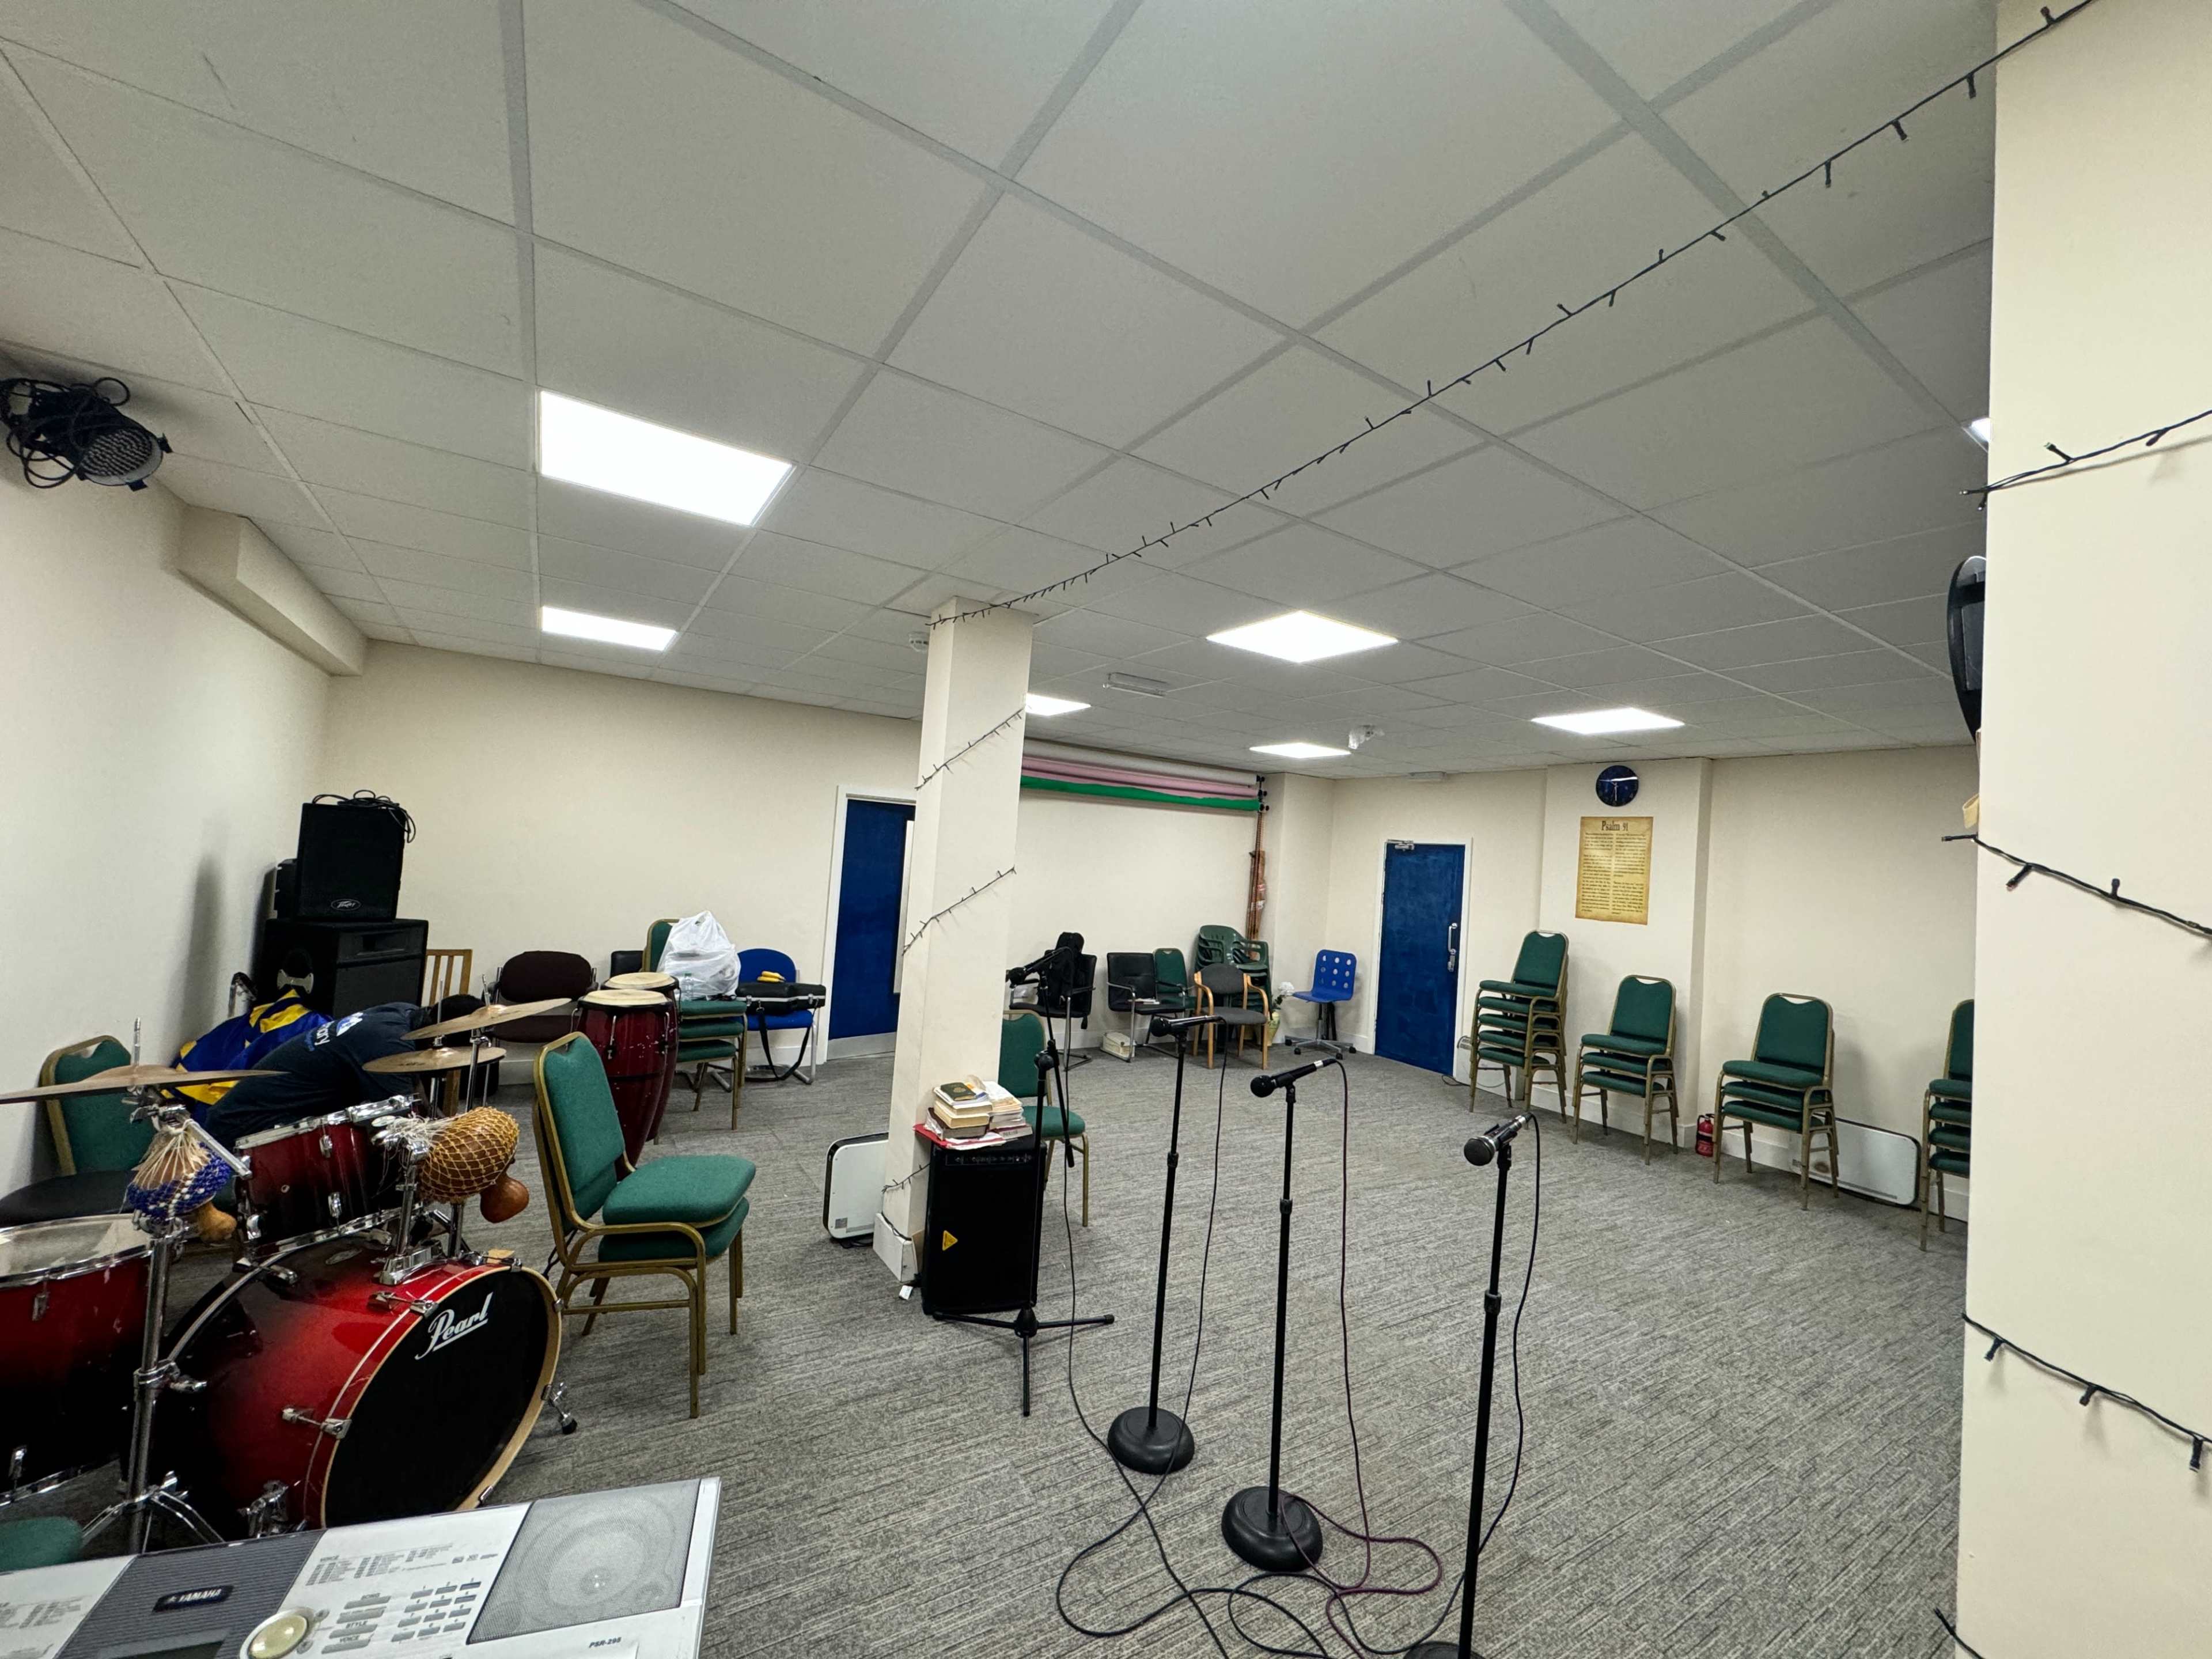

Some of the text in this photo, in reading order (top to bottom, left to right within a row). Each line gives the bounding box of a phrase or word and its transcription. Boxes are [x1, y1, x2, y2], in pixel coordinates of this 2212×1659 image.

[1601, 820, 1620, 831] Psalm
[414, 1291, 493, 1360] Pearl
[179, 1588, 222, 1603] YAMAHA
